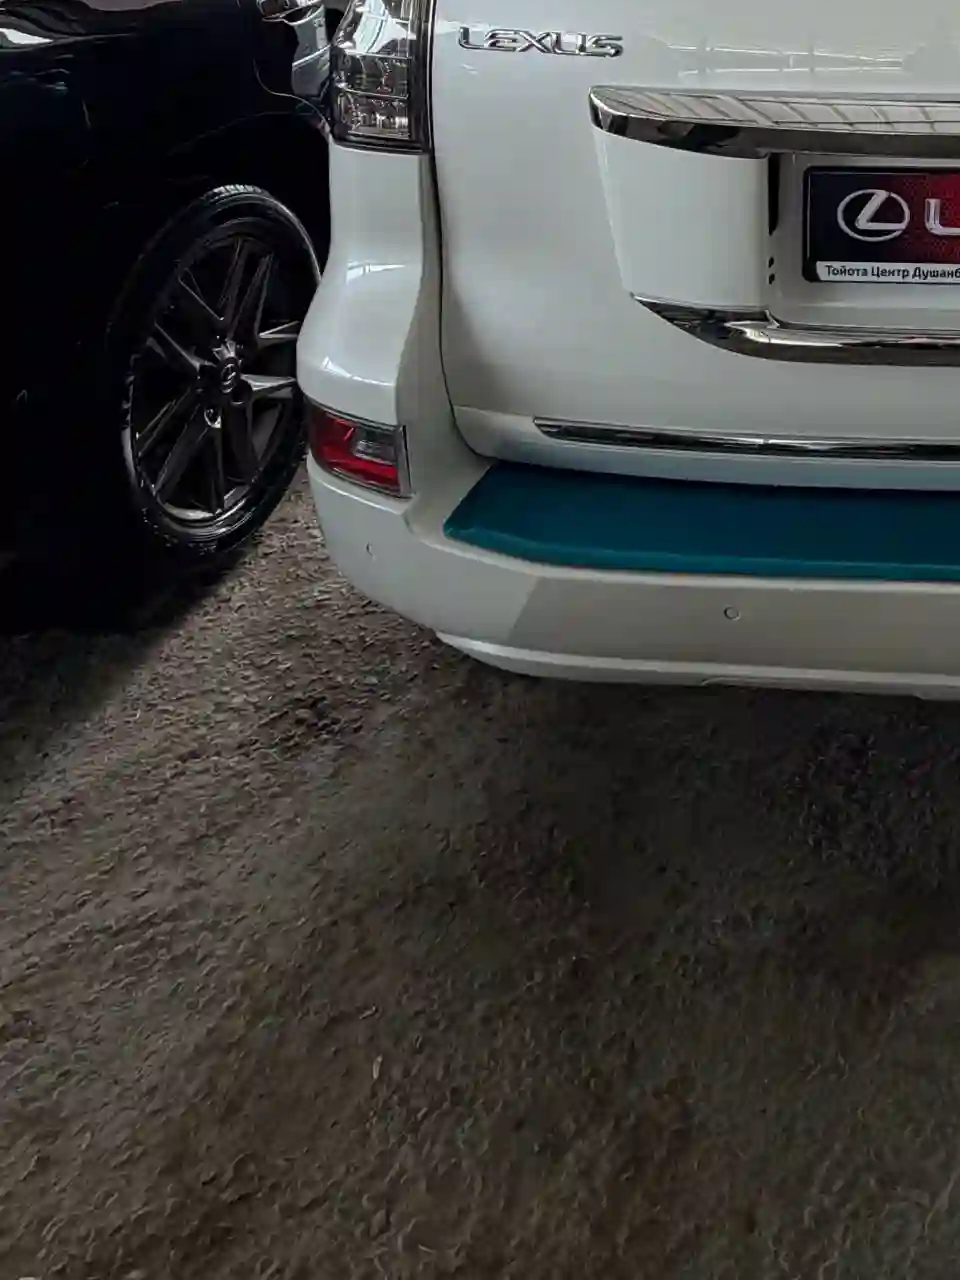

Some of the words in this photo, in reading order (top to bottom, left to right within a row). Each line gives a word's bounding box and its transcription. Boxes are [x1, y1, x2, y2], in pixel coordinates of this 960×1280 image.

[457, 26, 623, 58] LEXUS
[825, 264, 867, 277] Тойота
[871, 265, 910, 280] Центр
